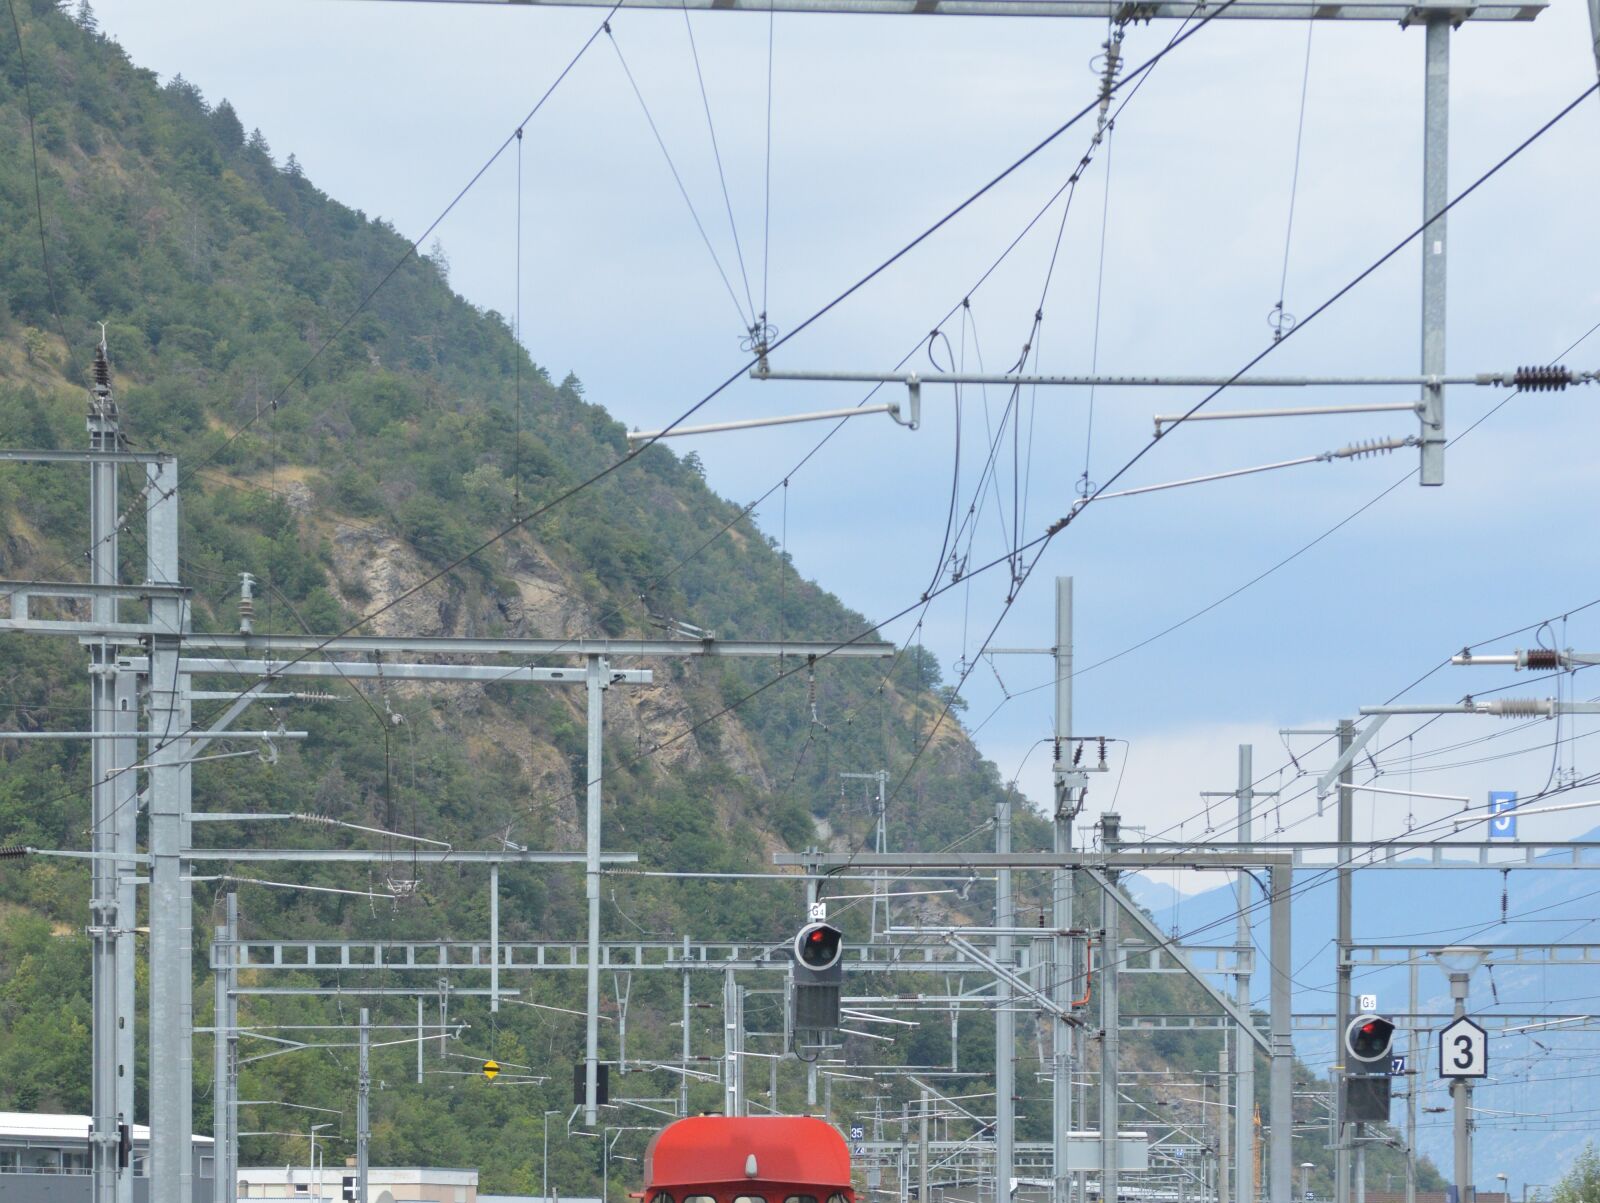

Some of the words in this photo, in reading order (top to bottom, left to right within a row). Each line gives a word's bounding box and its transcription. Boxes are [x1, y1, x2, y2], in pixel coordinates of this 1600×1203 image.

[1495, 799, 1510, 831] 5
[812, 905, 824, 916] G4
[1453, 1034, 1473, 1069] 3
[851, 1127, 863, 1139] 35
